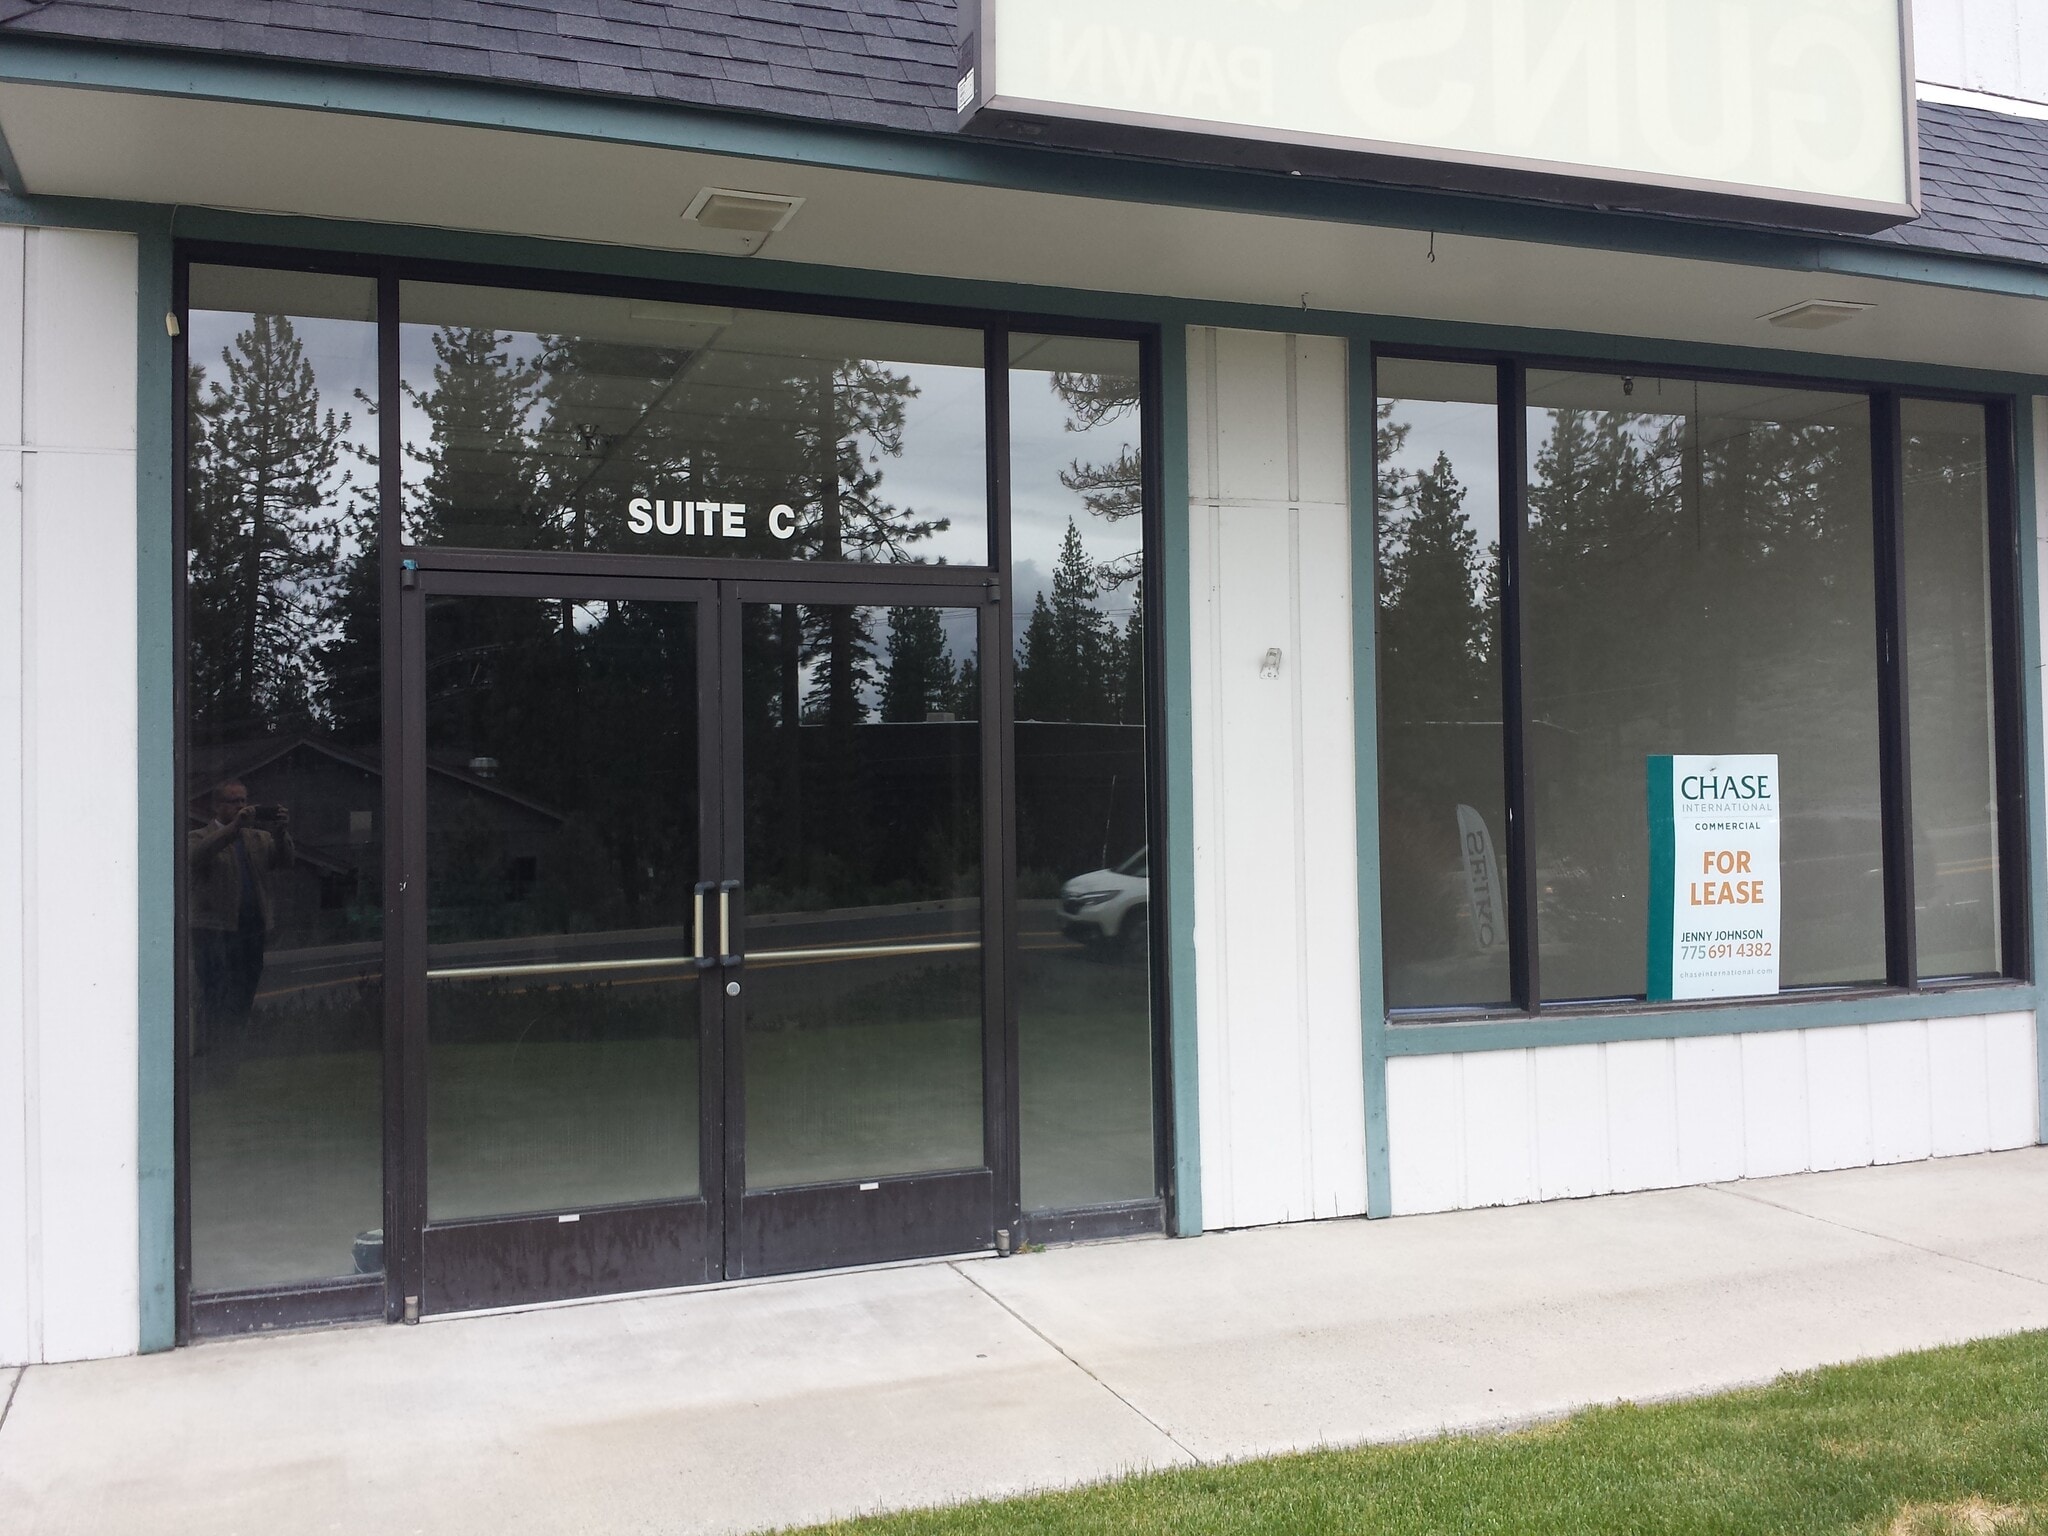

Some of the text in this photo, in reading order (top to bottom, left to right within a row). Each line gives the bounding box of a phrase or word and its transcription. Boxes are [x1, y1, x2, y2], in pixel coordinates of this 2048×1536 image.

[627, 497, 796, 539] SUITE C
[1681, 775, 1771, 800] CHASE
[1682, 803, 1772, 812] INTERNATIONAL
[1695, 822, 1761, 831] COMMERCIAL
[1703, 851, 1751, 874] FOR
[1690, 880, 1764, 906] LEASE
[1681, 929, 1763, 943] JENNY JOHNSON
[1681, 942, 1772, 960] 775 691 4382
[1680, 968, 1773, 979] chaseinternational.com
